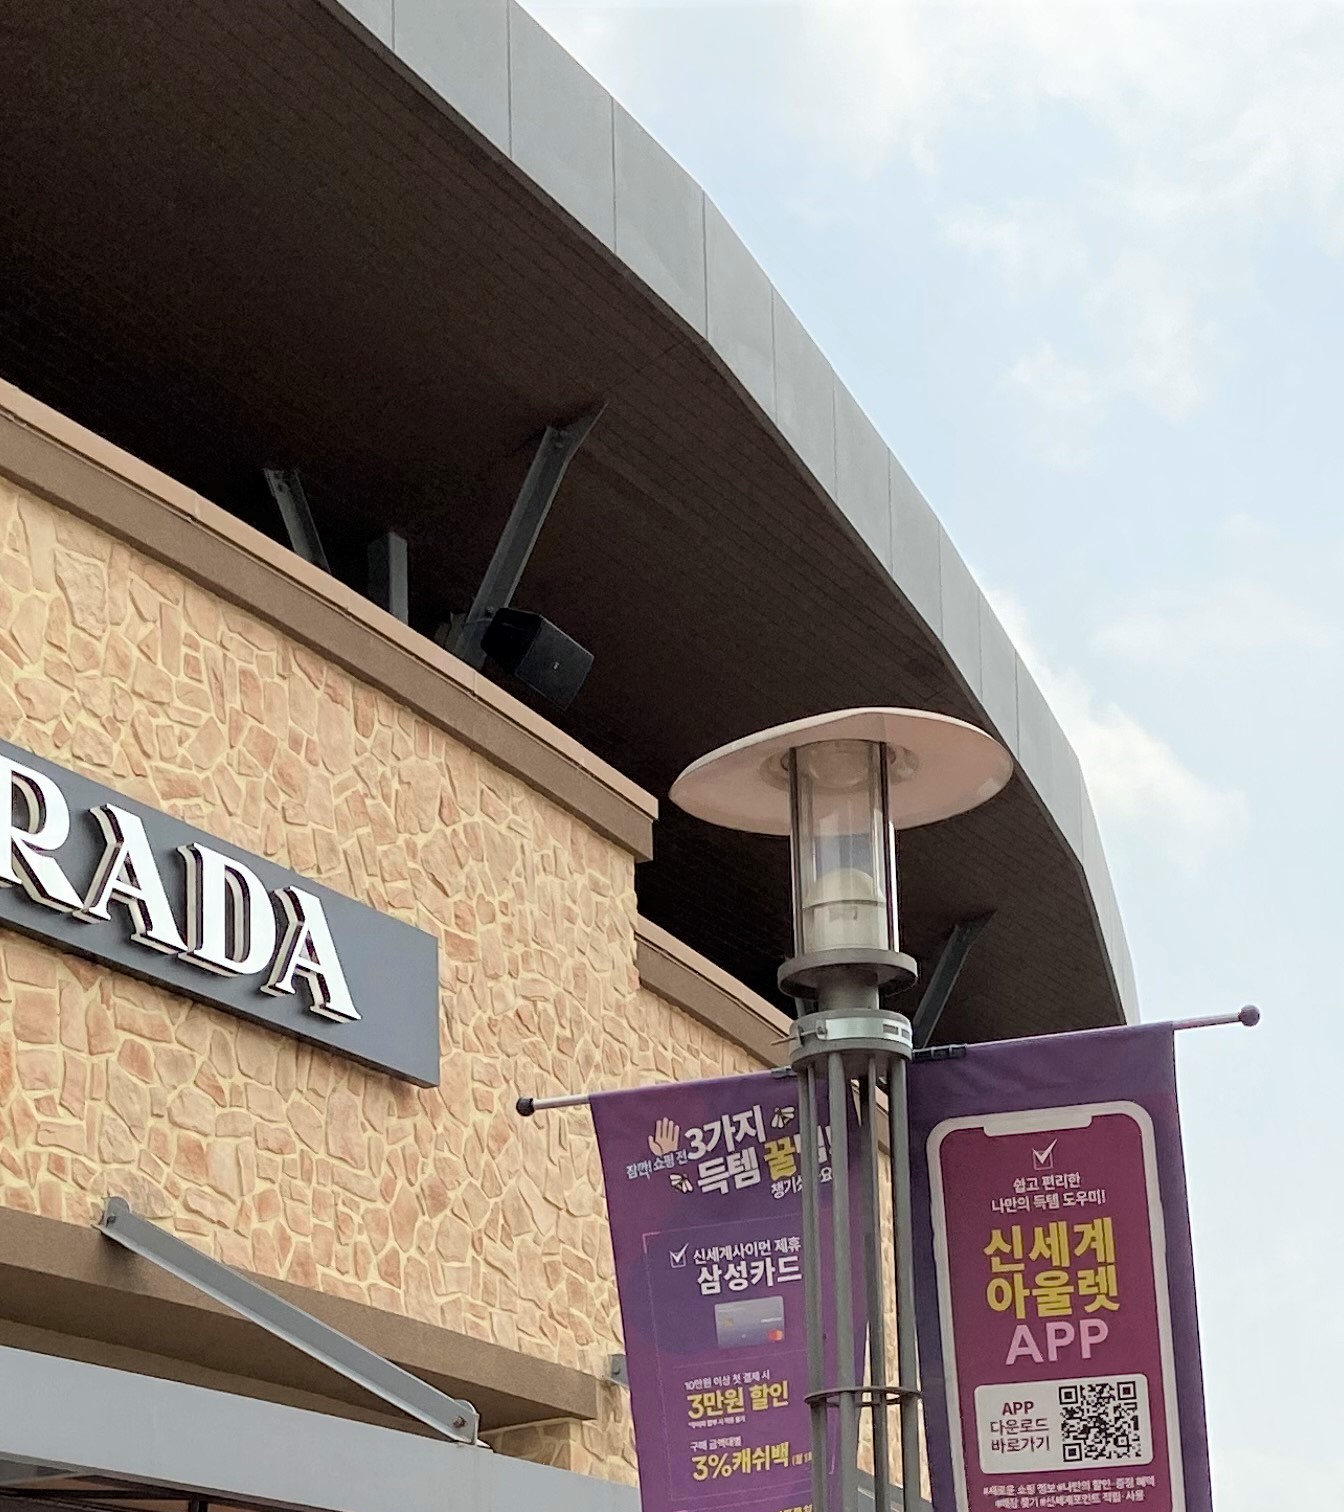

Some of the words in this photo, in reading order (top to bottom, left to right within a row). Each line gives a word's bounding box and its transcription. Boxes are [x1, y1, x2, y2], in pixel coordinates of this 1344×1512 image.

[685, 1104, 766, 1160] 3가지
[653, 1154, 675, 1172] 쇼핑
[675, 1150, 688, 1165] 전
[697, 1147, 761, 1194] 득템
[1013, 1176, 1040, 1194] 쉽고
[1042, 1172, 1080, 1190] 편리한
[991, 1195, 1030, 1214] 나만의
[1033, 1192, 1059, 1210] 득템
[1062, 1189, 1106, 1207] 도우미!
[693, 1239, 771, 1265] 신세계사이먼
[774, 1236, 802, 1254] 제휴
[983, 1217, 1116, 1273] 신세계
[697, 1256, 802, 1295] 삼성카드
[986, 1265, 1120, 1320] 아울렛
[1006, 1318, 1109, 1365] APP
[684, 1377, 712, 1391] 10만원
[713, 1374, 731, 1387] 이상
[761, 1369, 770, 1380] 시
[687, 1386, 745, 1419] 3만원
[748, 1380, 789, 1411] 할인
[1002, 1401, 1034, 1416] APP
[990, 1418, 1050, 1436] 다운로드
[692, 1441, 789, 1481] 3%캐쉬백
[991, 1435, 1050, 1454] 바로가기
